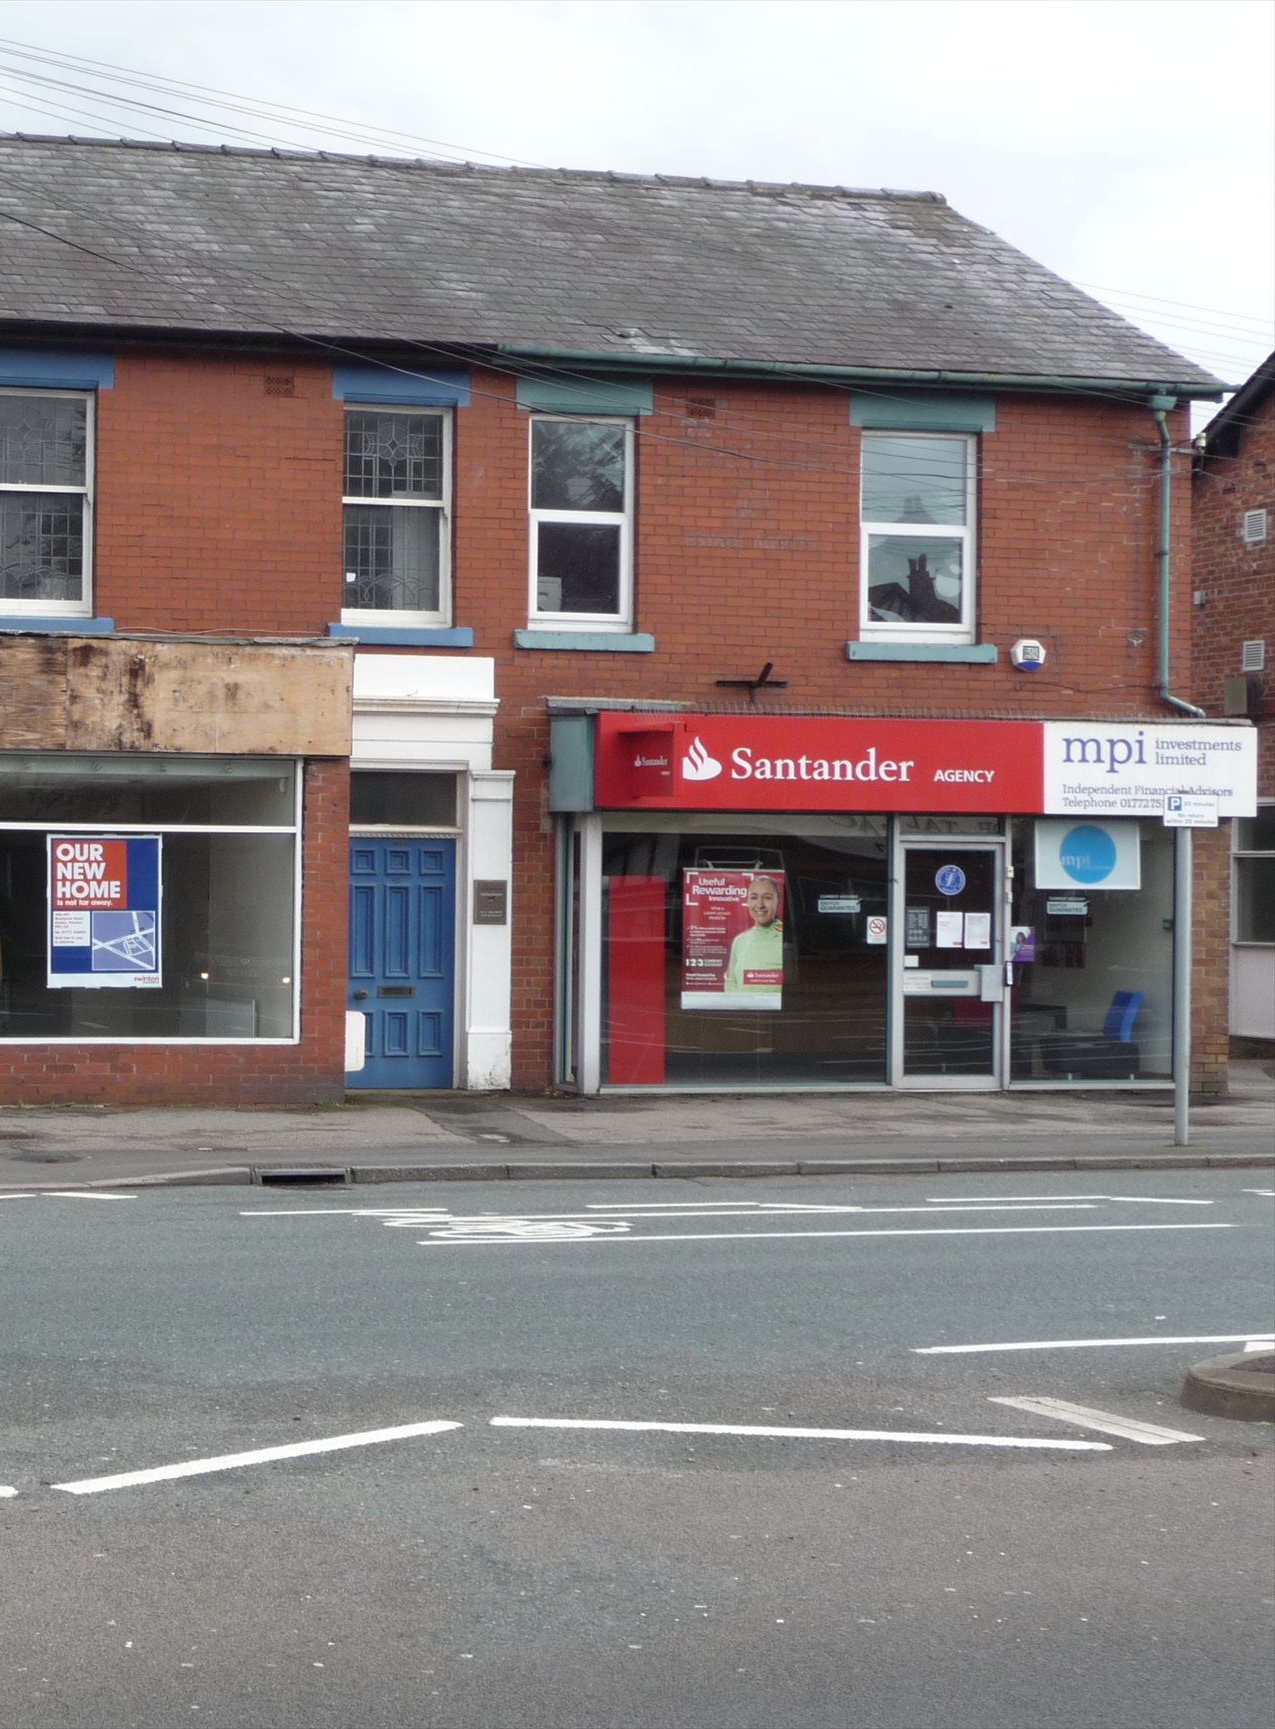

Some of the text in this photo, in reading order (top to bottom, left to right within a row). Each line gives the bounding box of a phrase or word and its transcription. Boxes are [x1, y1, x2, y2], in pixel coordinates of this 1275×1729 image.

[1155, 738, 1242, 751] investments
[1062, 731, 1147, 773] mpi
[1155, 752, 1206, 766] limited
[731, 747, 914, 782] Santander
[934, 769, 995, 783] AGENCY
[1062, 784, 1234, 797] Independent Financial Advisors
[1062, 797, 1117, 809] Telephone
[1170, 797, 1181, 810] P
[56, 843, 104, 861] OUR
[1061, 853, 1091, 869] mpi
[56, 862, 106, 880] NEW
[698, 878, 725, 886] Useful
[56, 881, 120, 899] HOME
[692, 885, 747, 897] Rewarding
